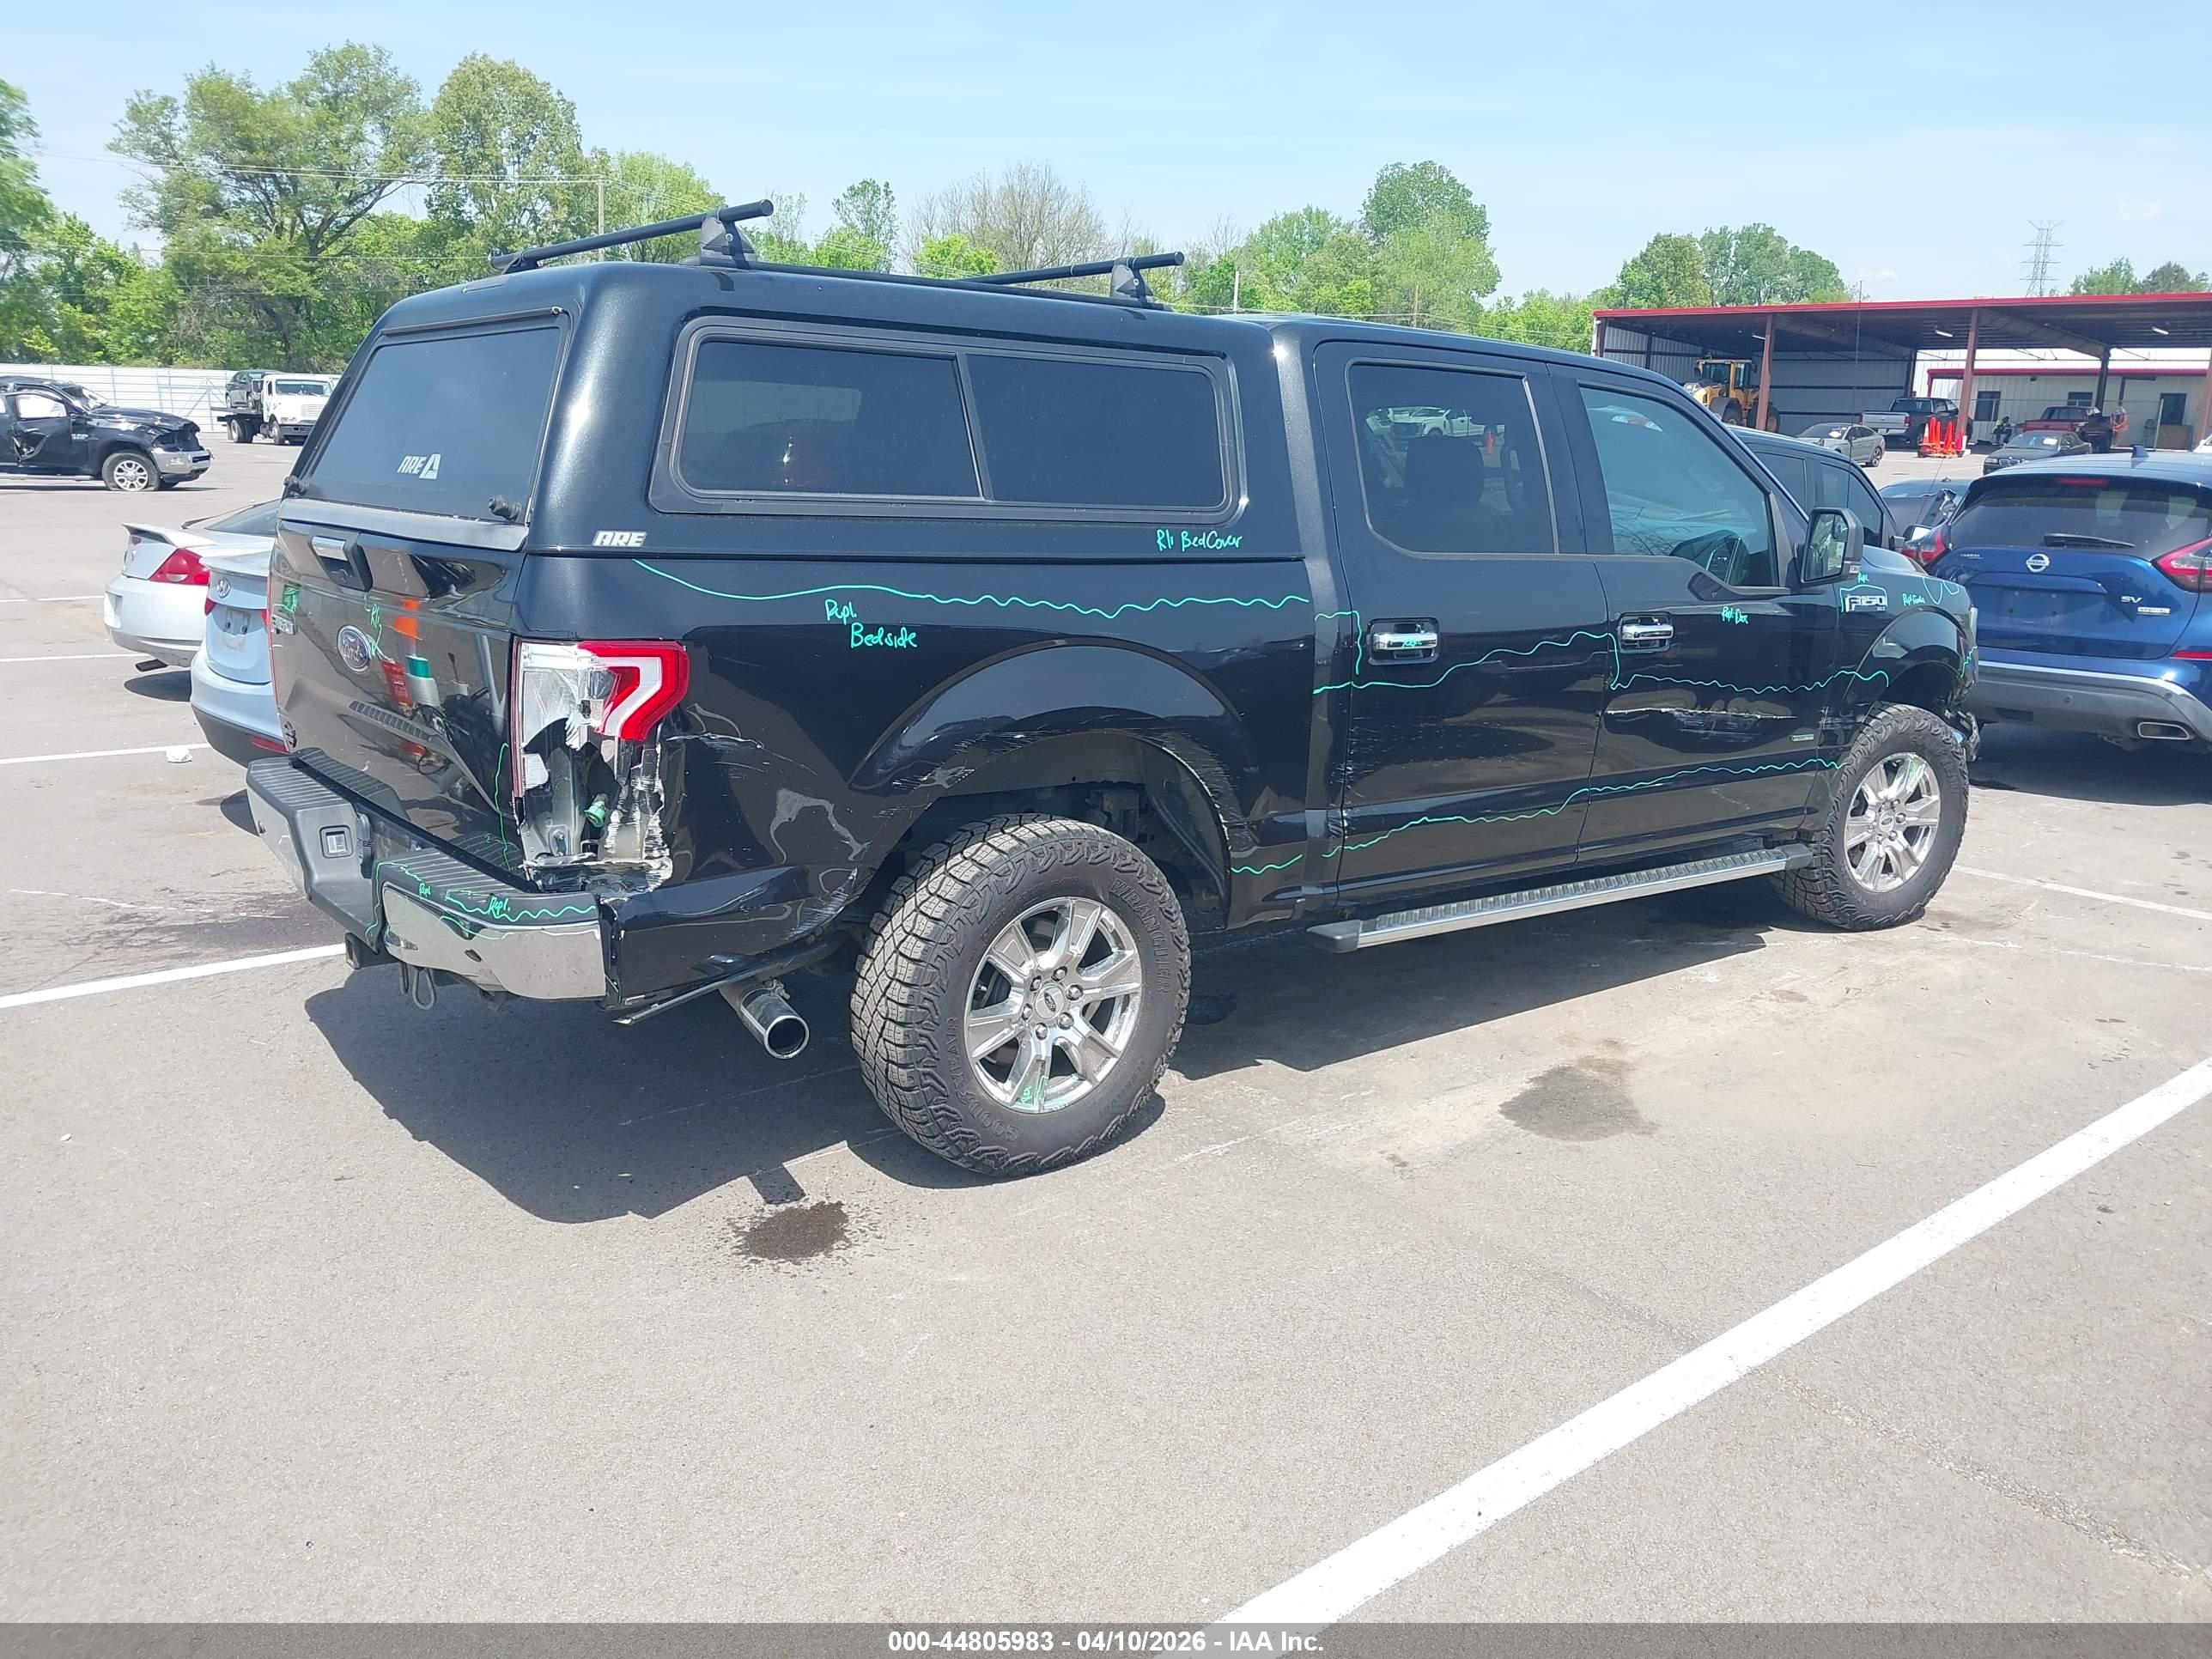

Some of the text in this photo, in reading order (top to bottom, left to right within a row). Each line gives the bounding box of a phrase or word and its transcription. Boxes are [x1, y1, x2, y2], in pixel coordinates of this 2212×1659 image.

[397, 455, 428, 475] ARE
[592, 530, 647, 548] ARE
[2121, 595, 2143, 604] SV
[850, 622, 918, 649] Bedside
[1109, 878, 1171, 994] WRANGLER
[946, 1016, 1020, 1143] GOODYEAR
